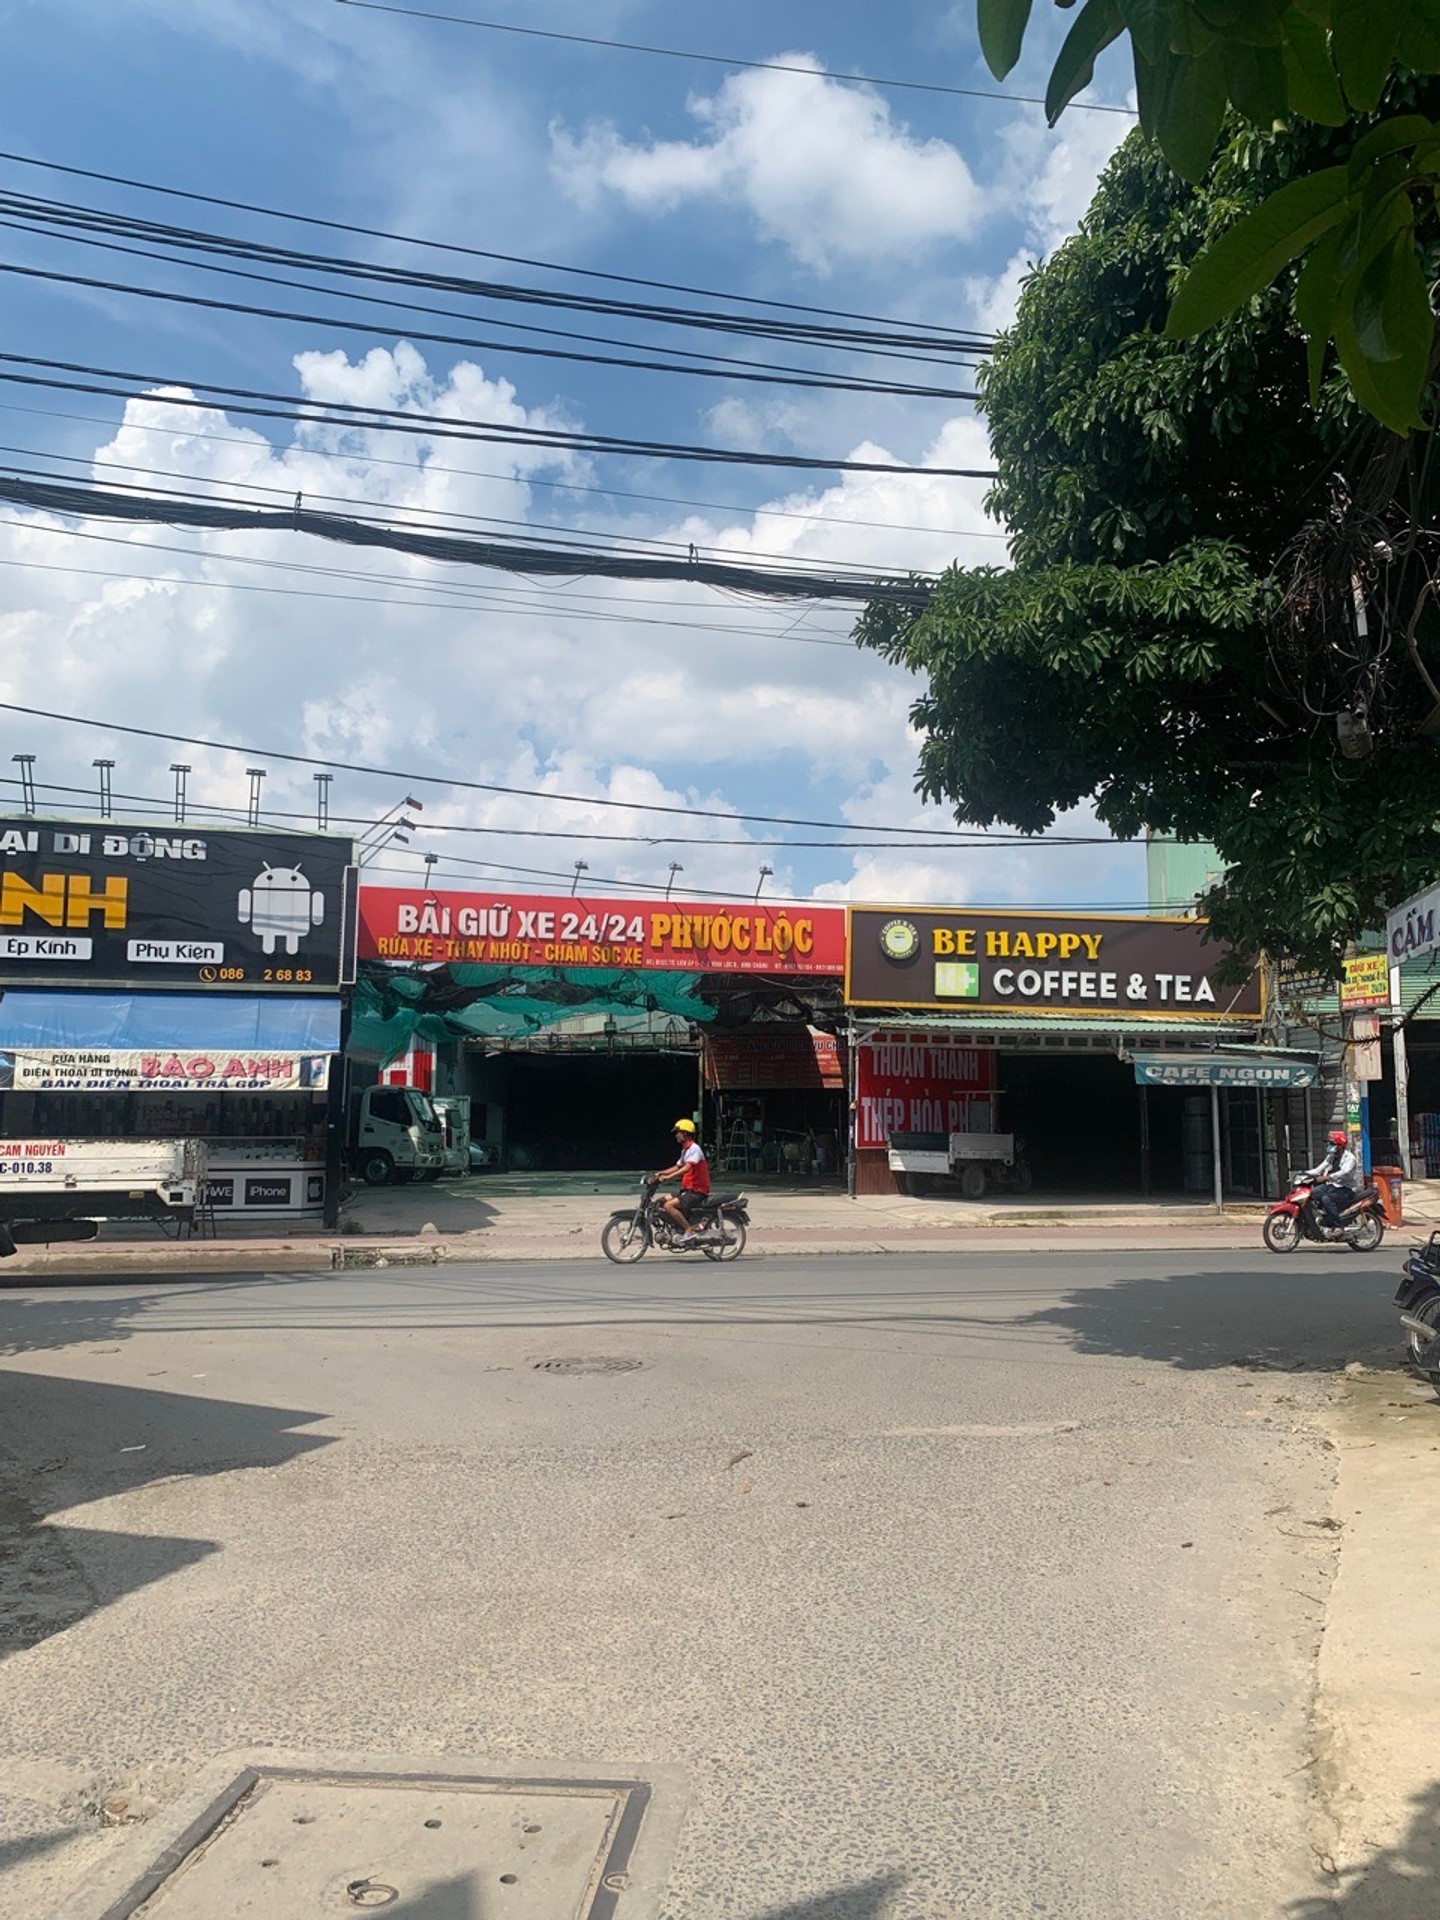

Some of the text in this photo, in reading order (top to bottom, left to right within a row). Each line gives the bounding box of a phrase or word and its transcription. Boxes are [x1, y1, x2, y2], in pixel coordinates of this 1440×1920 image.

[54, 833, 91, 855] DI
[102, 832, 207, 861] ĐỘNG
[0, 872, 128, 929] NH
[397, 900, 813, 960] BÃI GIỮ XE 24/24 PHƯỚC LỘC
[7, 938, 77, 956] Ép Kính
[136, 943, 169, 959] Phụ
[414, 939, 432, 957] XE
[446, 940, 486, 958] THAY
[545, 941, 588, 963] CHĂM
[592, 943, 621, 963] SÓC
[624, 948, 642, 964] XE
[933, 928, 1103, 960] BE HAPPY
[219, 968, 244, 980] 086
[993, 968, 1216, 1002] COFFEE & TEA
[141, 1053, 293, 1079] BẢO ANH
[1219, 1067, 1290, 1080] NGON
[250, 1186, 287, 1197] iPhone
